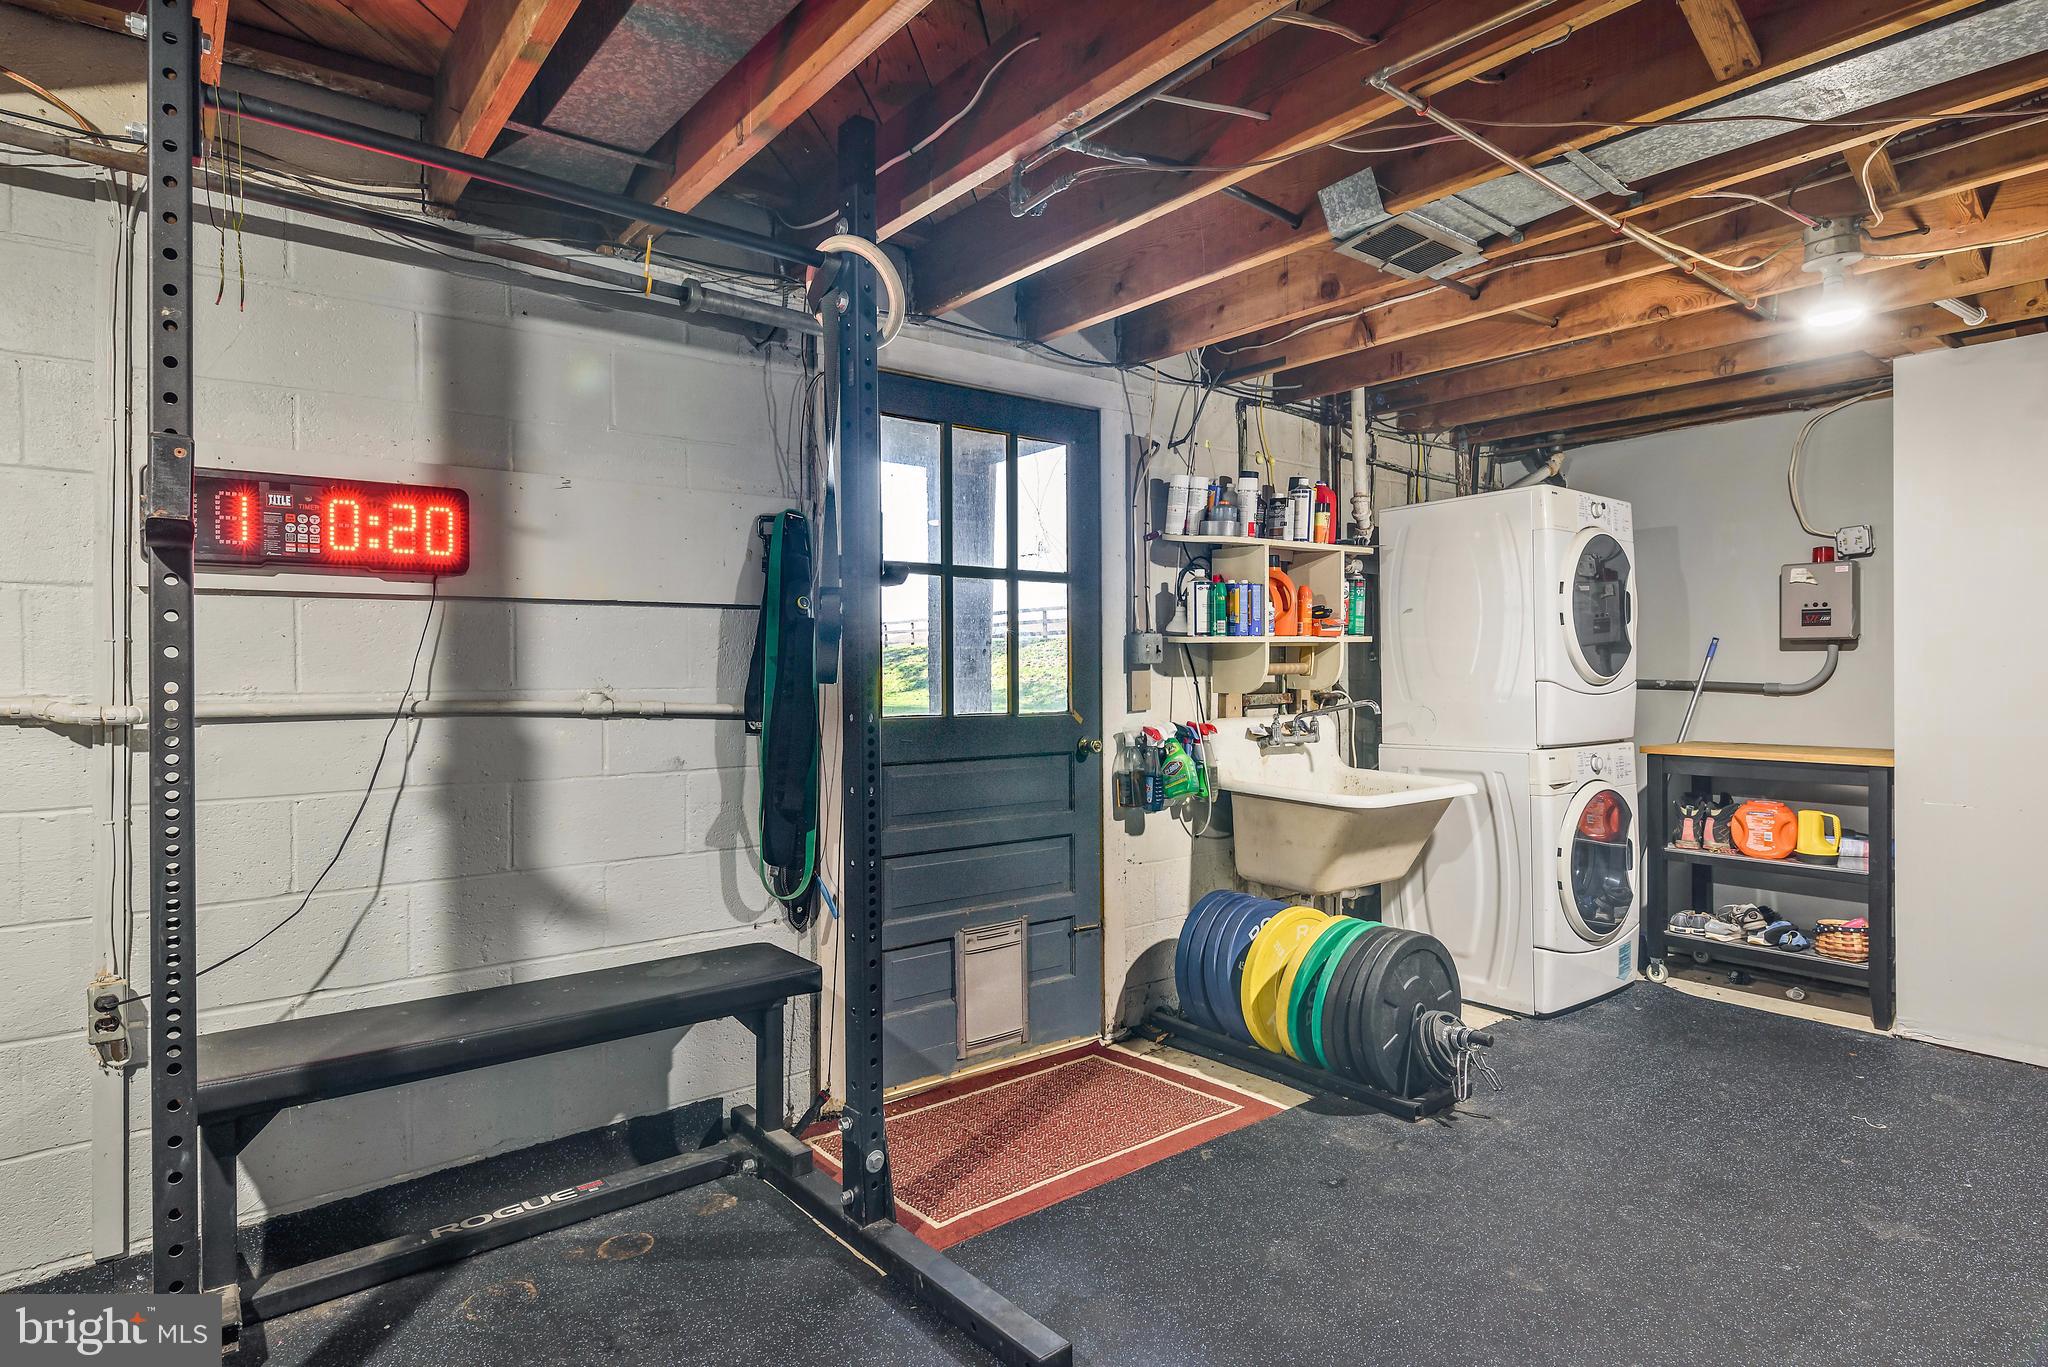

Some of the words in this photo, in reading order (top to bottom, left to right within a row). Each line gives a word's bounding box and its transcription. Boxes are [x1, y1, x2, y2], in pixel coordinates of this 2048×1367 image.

[268, 494, 292, 507] TITLE
[298, 503, 320, 511] TIMER
[329, 499, 453, 556] 0:20
[430, 1187, 578, 1239] ROGUE
